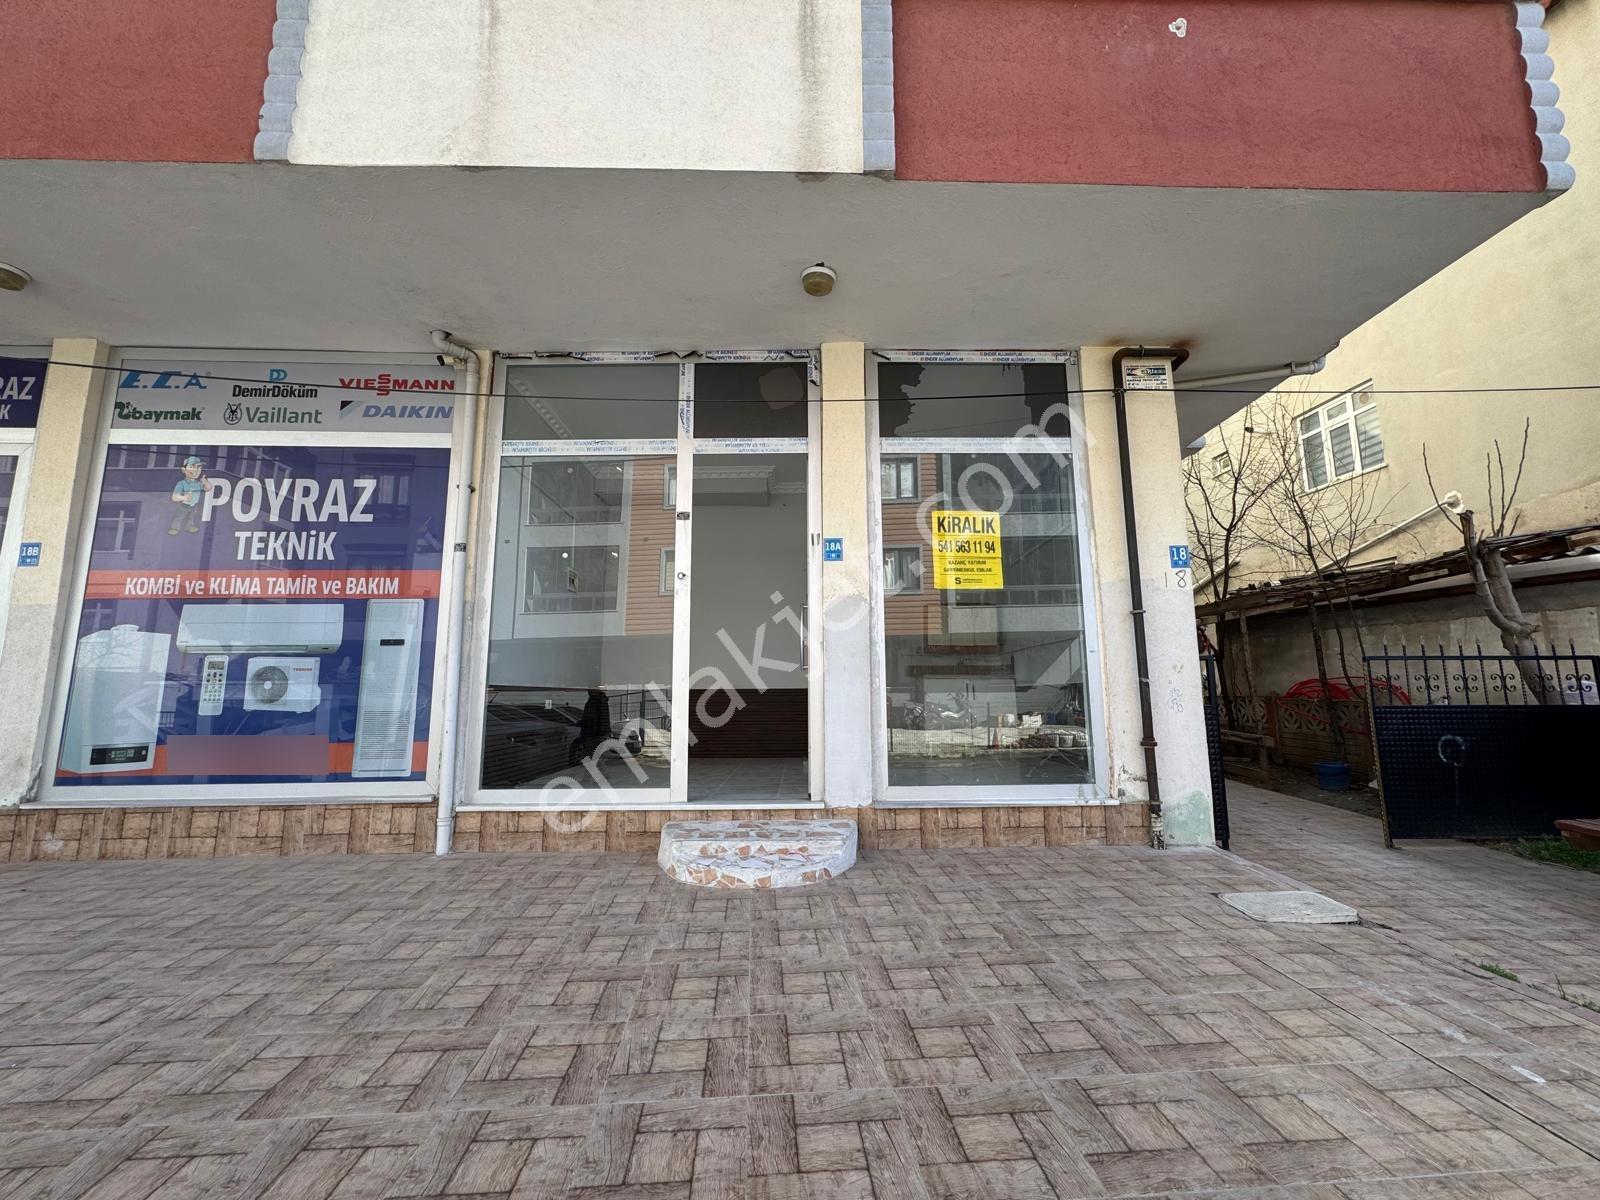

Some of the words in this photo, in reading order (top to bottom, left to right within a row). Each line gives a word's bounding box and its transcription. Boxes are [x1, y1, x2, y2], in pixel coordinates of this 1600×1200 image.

[232, 384, 318, 399] DemirDöküm
[339, 373, 455, 396] VIESSMANN
[132, 407, 202, 423] baymak
[246, 407, 323, 424] Vaillant
[362, 404, 454, 419] DAIKIN
[200, 477, 378, 523] POYRAZ
[22, 546, 39, 556] 18B
[825, 542, 841, 551] 18A
[938, 540, 953, 553] 541
[955, 540, 971, 553] 563
[973, 541, 983, 553] 11
[984, 541, 996, 554] 94
[1171, 547, 1187, 560] 18
[125, 575, 181, 595] KOMBİ
[185, 579, 203, 595] ve
[209, 574, 261, 595] KLİMA
[267, 574, 317, 596] TAMİR
[322, 579, 342, 595] ve
[345, 577, 399, 595] BAKIM
